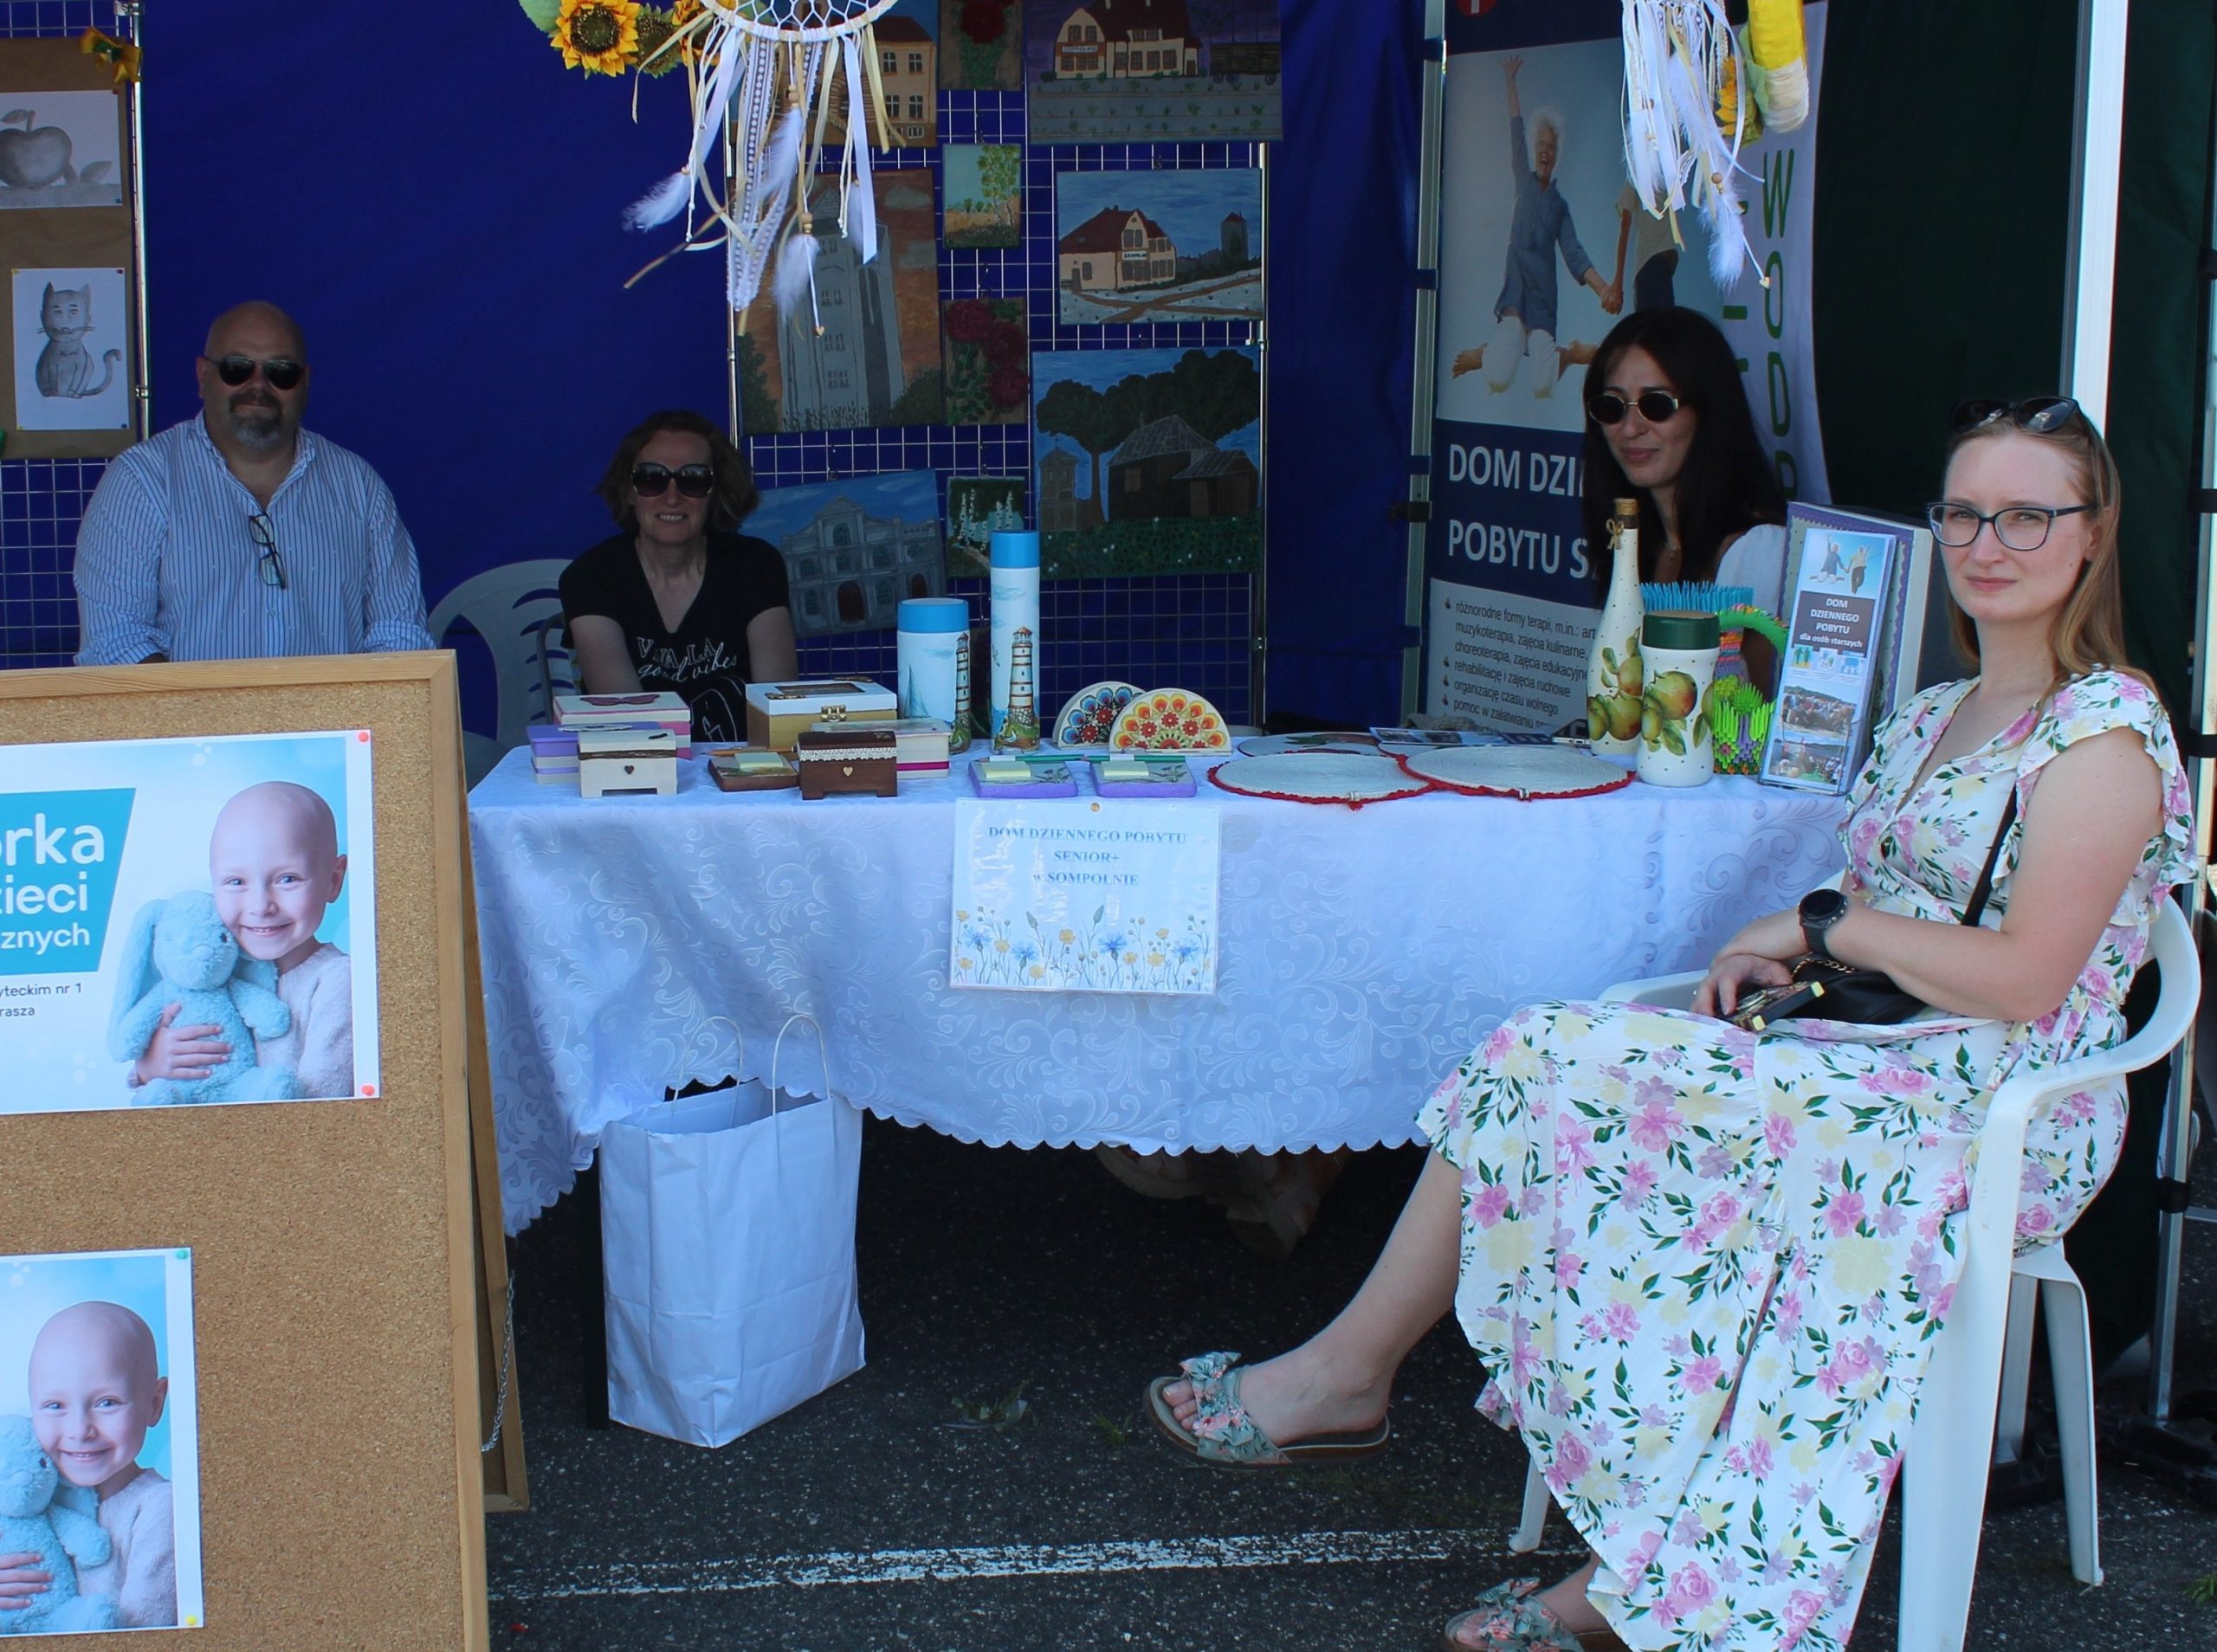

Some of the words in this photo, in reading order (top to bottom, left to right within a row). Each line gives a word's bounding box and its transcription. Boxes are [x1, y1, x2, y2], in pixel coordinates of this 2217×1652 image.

[1449, 444, 1521, 489] DOM
[1529, 453, 1584, 498] DZI
[1448, 519, 1561, 575] POBYTU
[1569, 538, 1599, 579] S
[1826, 597, 1848, 608] DOM
[1456, 601, 1503, 621] różnorodne
[1503, 609, 1526, 628] formy
[1810, 609, 1859, 623] DZIENNEGO
[1815, 623, 1850, 635] POBYTU
[1517, 634, 1545, 651] zajęcia
[1800, 633, 1811, 642] dla
[1830, 638, 1862, 648] starszych
[693, 642, 736, 679] vibes
[1513, 654, 1541, 670] zajęcia
[1454, 660, 1503, 684] rehabilitację
[1508, 673, 1535, 690] zajęcia
[1536, 680, 1571, 698] ruchowe
[1454, 680, 1500, 703] organizację
[1501, 691, 1524, 707] czasu
[1526, 696, 1558, 717] wolnego
[1453, 699, 1480, 715] pomoc
[1481, 707, 1489, 717] w
[0, 813, 104, 866] rka
[988, 827, 1024, 838] DOM
[1029, 828, 1120, 842] DZIENNEGO
[1125, 831, 1186, 845] POBYTU
[1053, 850, 1120, 863] SENIOR+
[1047, 872, 1139, 886] SOMPOLNIE
[0, 871, 87, 915] ieci
[0, 922, 90, 956] znych
[55, 985, 71, 995] nr
[75, 982, 81, 993] 1
